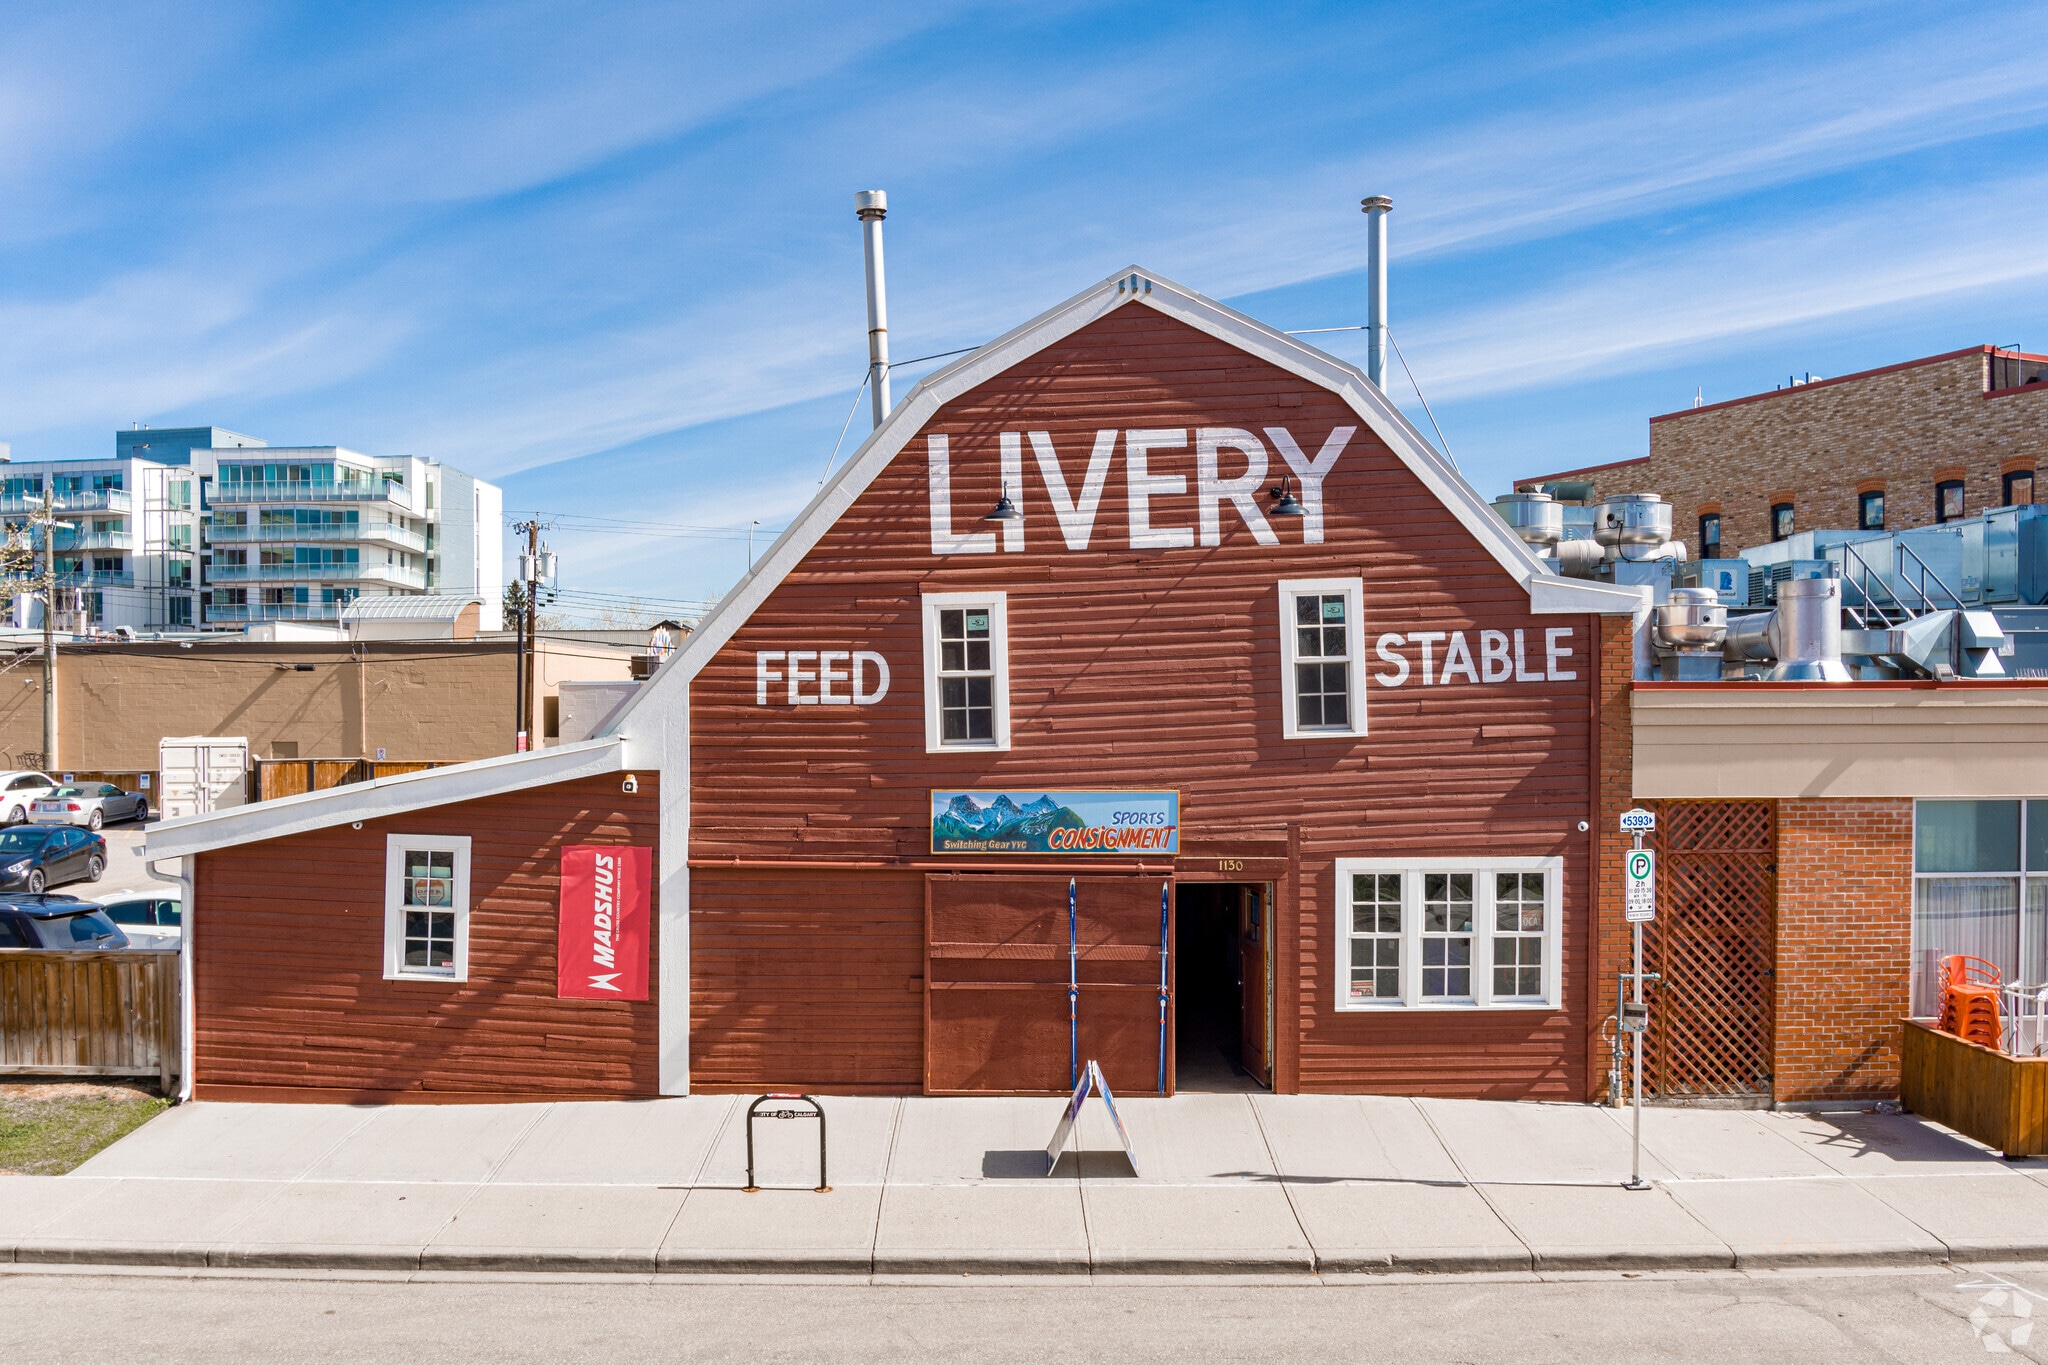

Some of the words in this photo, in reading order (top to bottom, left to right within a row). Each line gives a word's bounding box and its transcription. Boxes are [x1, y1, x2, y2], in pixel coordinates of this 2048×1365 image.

[927, 426, 1357, 554] LIVERY
[1374, 627, 1577, 687] STABLE
[757, 650, 890, 705] FEED
[1112, 811, 1165, 825] SPORTS
[1627, 815, 1649, 826] 5393
[944, 839, 987, 850] Switching
[988, 839, 1010, 849] Gear
[1011, 841, 1027, 849] YYC
[1219, 860, 1243, 871] 1130
[593, 853, 615, 969] MADSHUS
